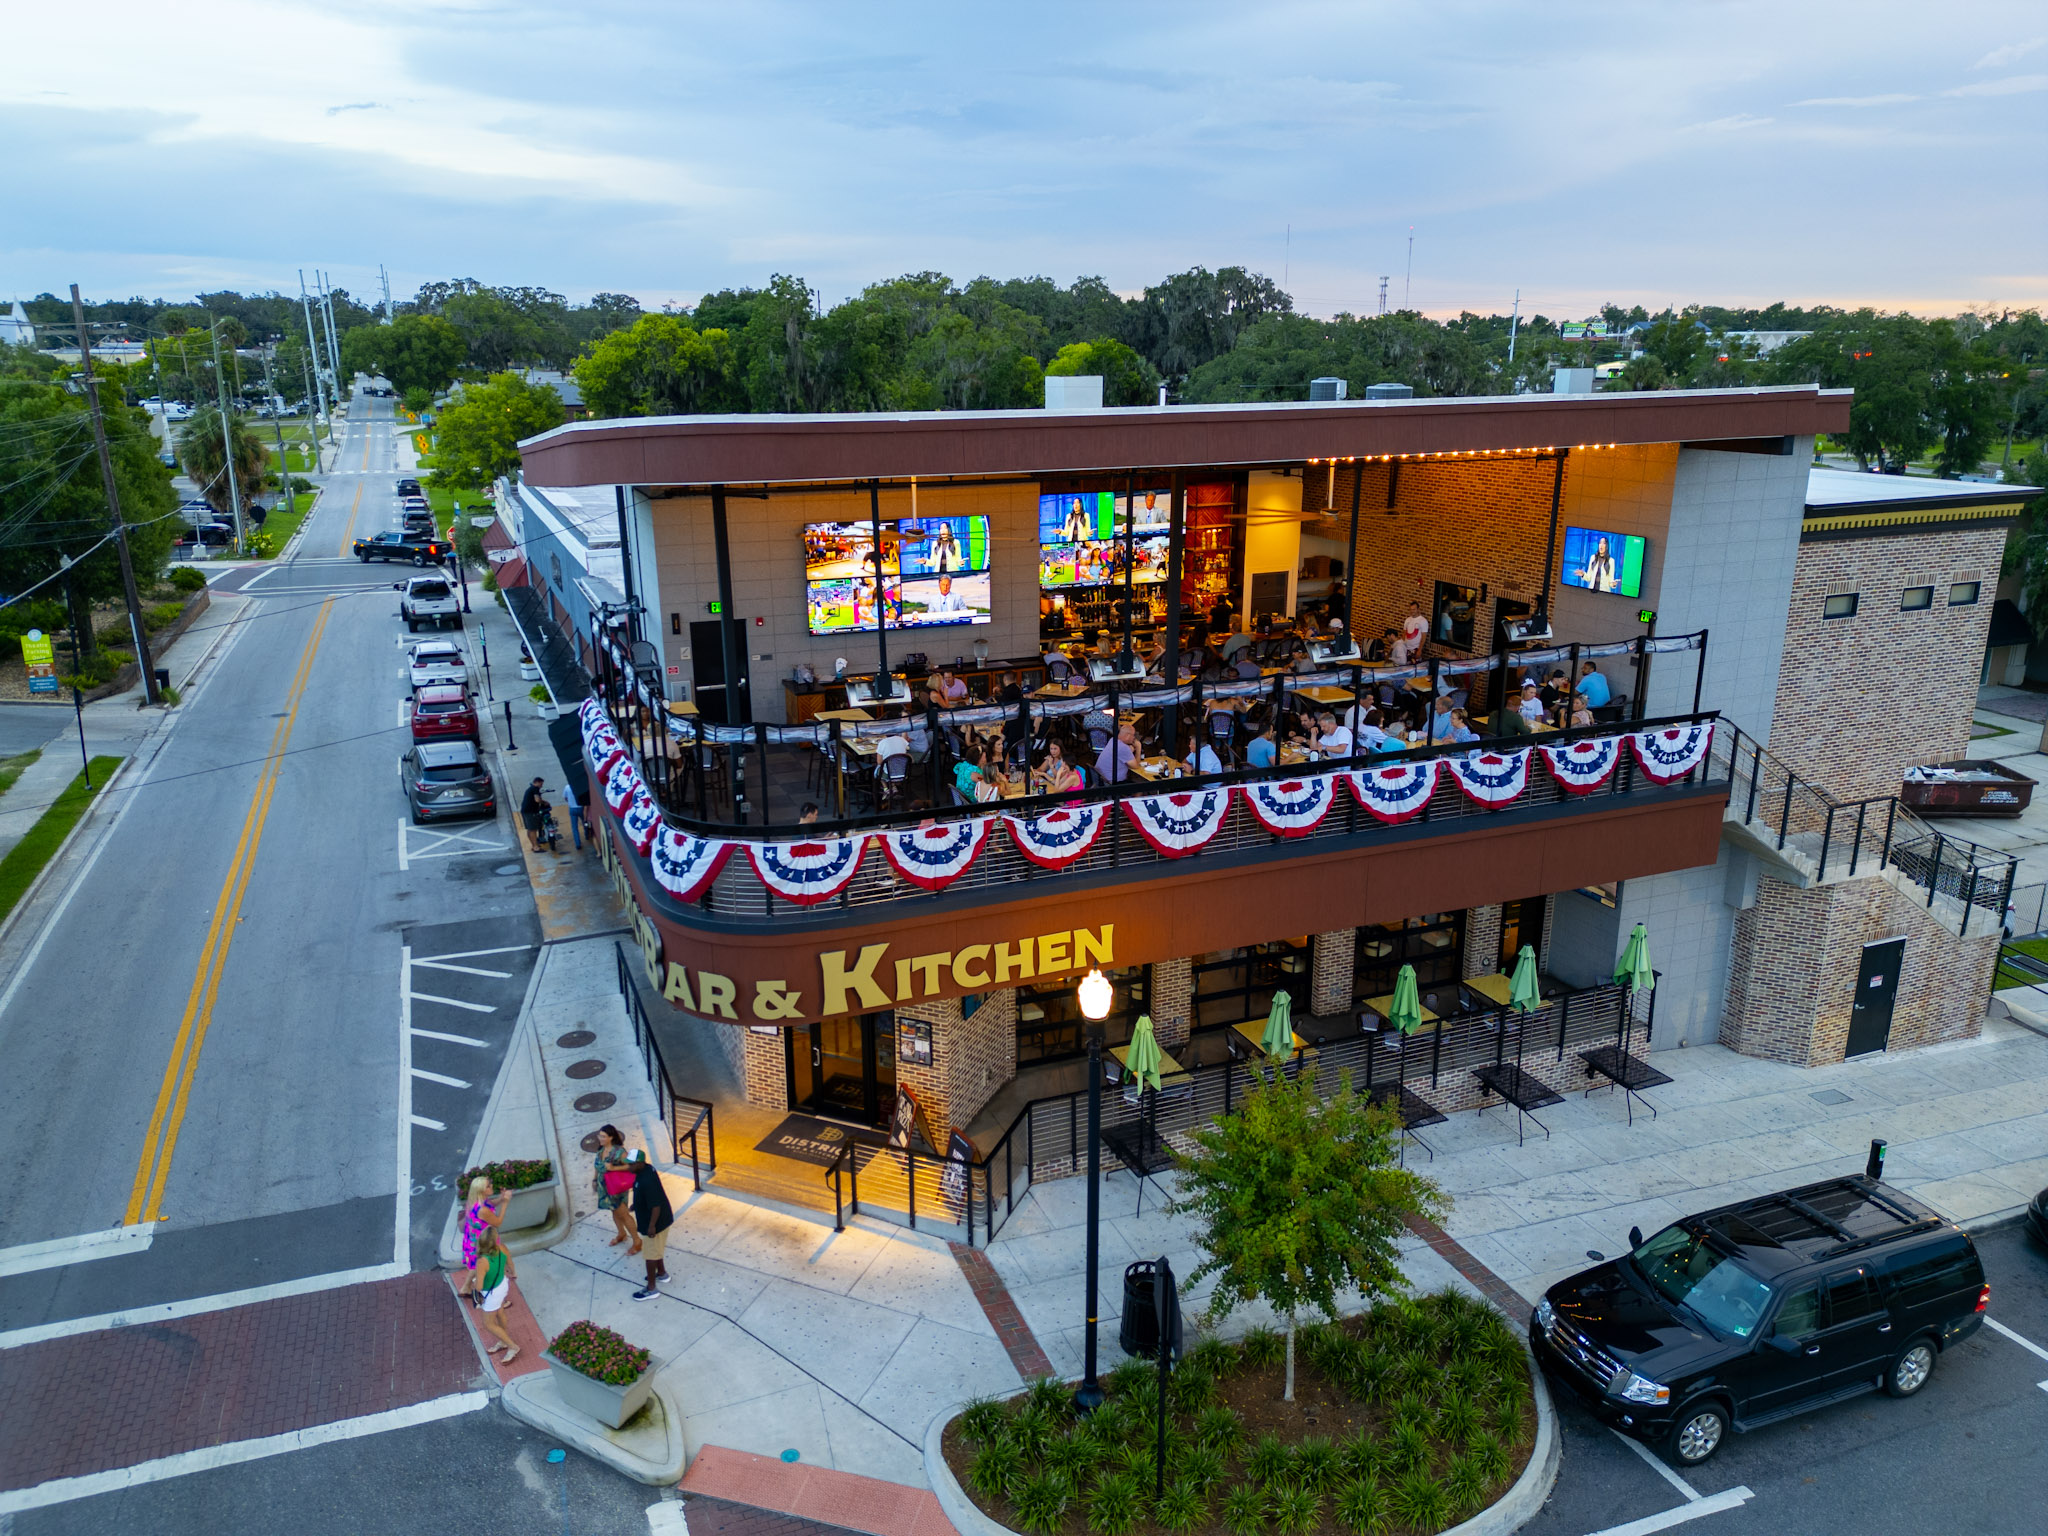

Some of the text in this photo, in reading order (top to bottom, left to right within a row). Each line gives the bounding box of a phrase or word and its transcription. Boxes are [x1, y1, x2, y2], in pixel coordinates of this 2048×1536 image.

[1640, 610, 1653, 622] EXIT
[753, 979, 806, 1020] &
[819, 924, 1116, 1017] KITCHEN
